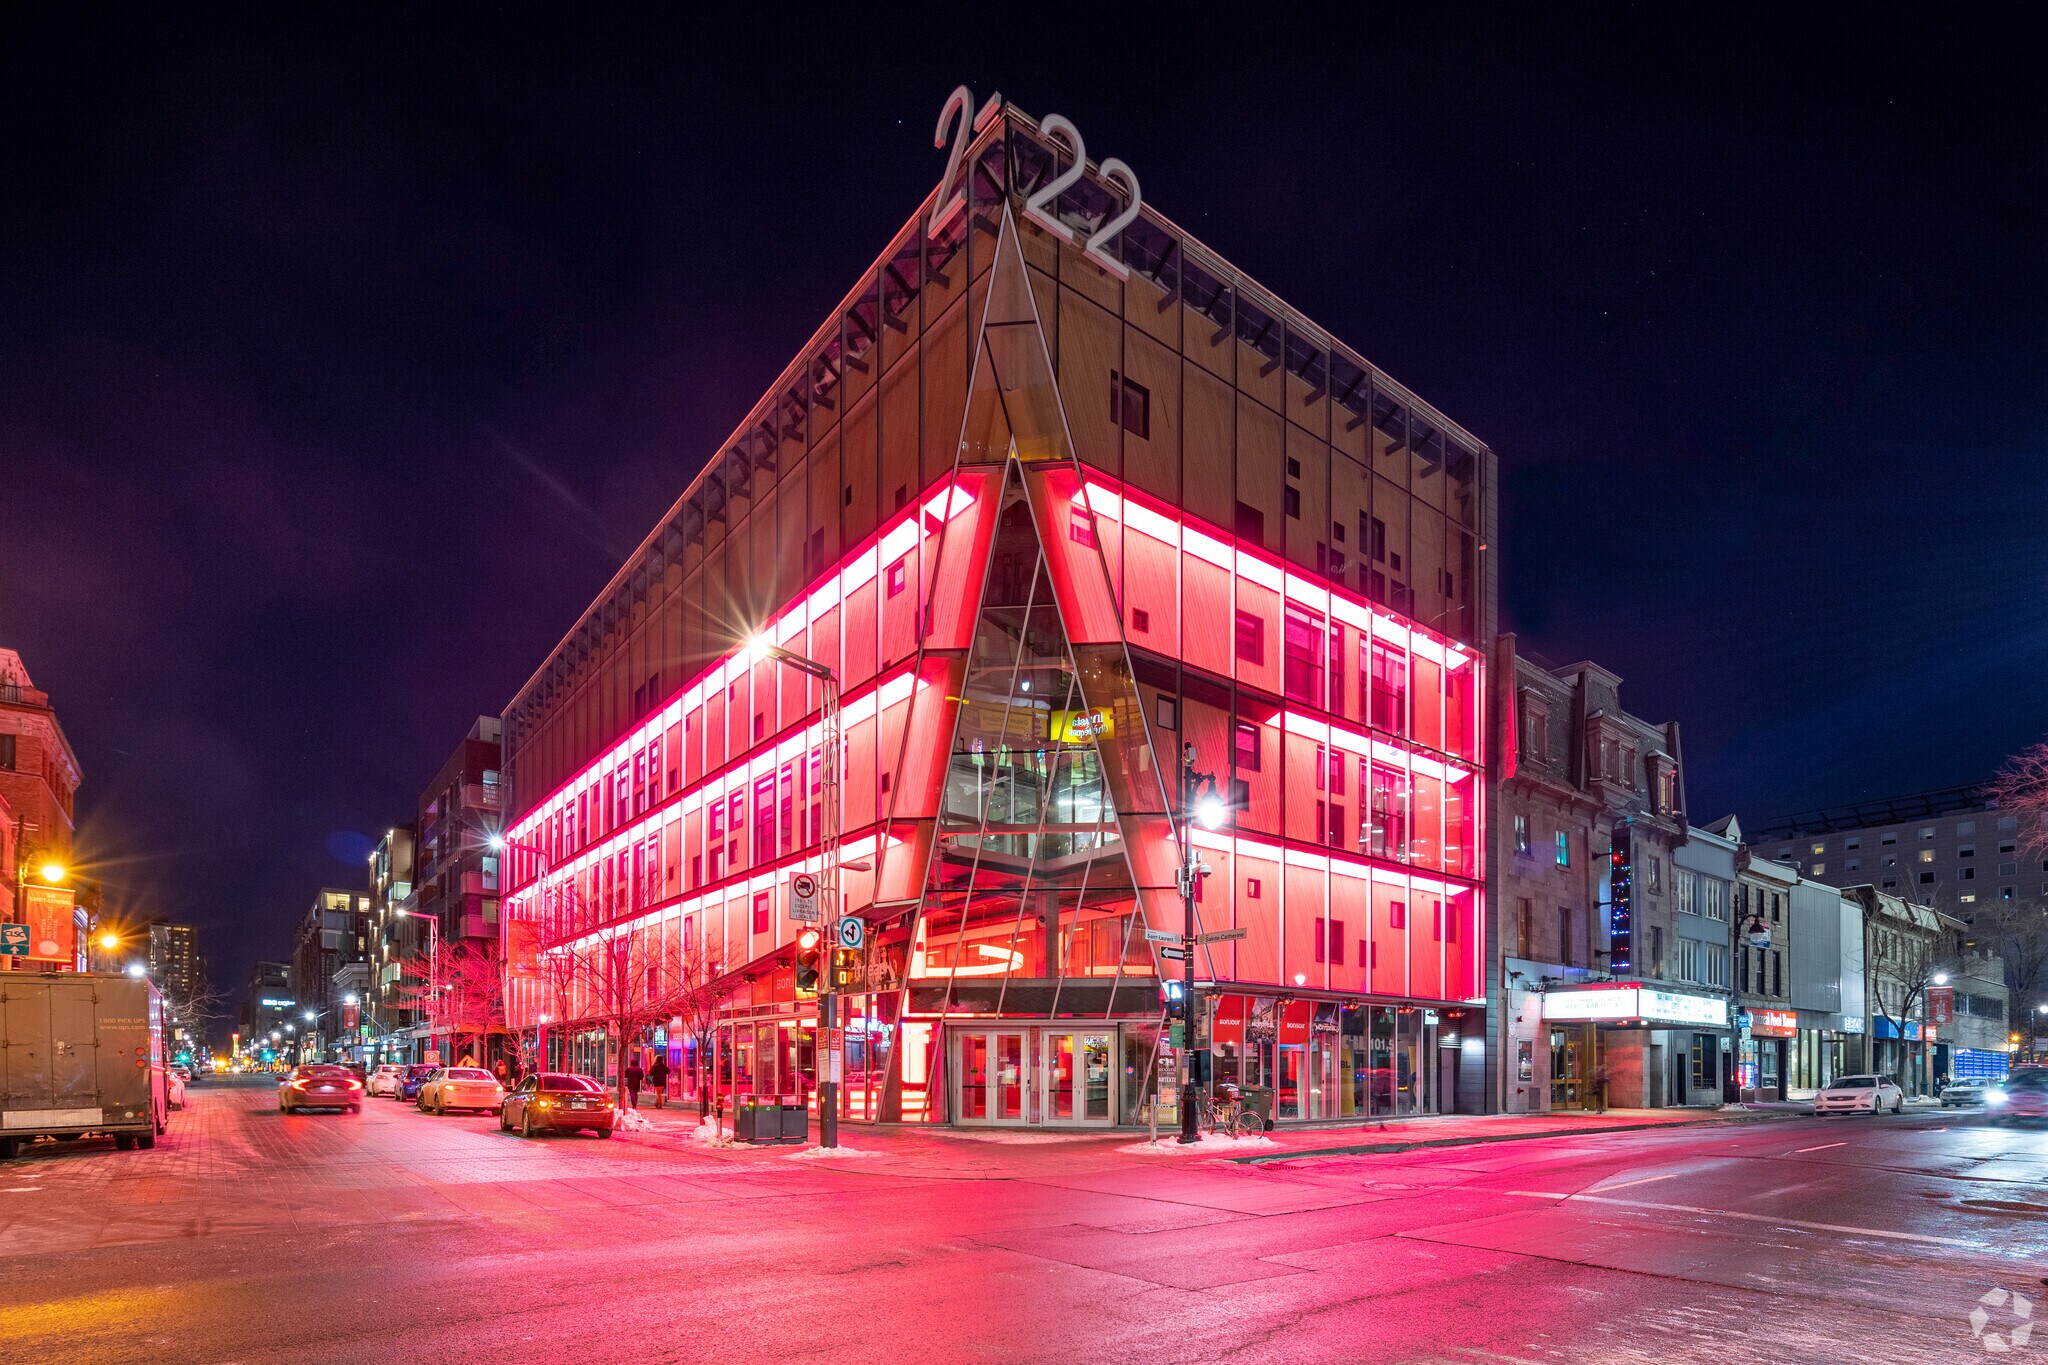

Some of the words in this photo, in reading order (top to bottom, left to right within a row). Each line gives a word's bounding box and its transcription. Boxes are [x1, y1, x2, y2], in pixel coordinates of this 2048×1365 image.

[5, 930, 25, 938] CLSC
[1147, 932, 1174, 942] Saint-Laurent
[1206, 932, 1244, 942] Sainte-Catherine
[1770, 1012, 1782, 1026] Pool
[1782, 1013, 1796, 1028] Room
[1370, 1038, 1394, 1052] 101,5
